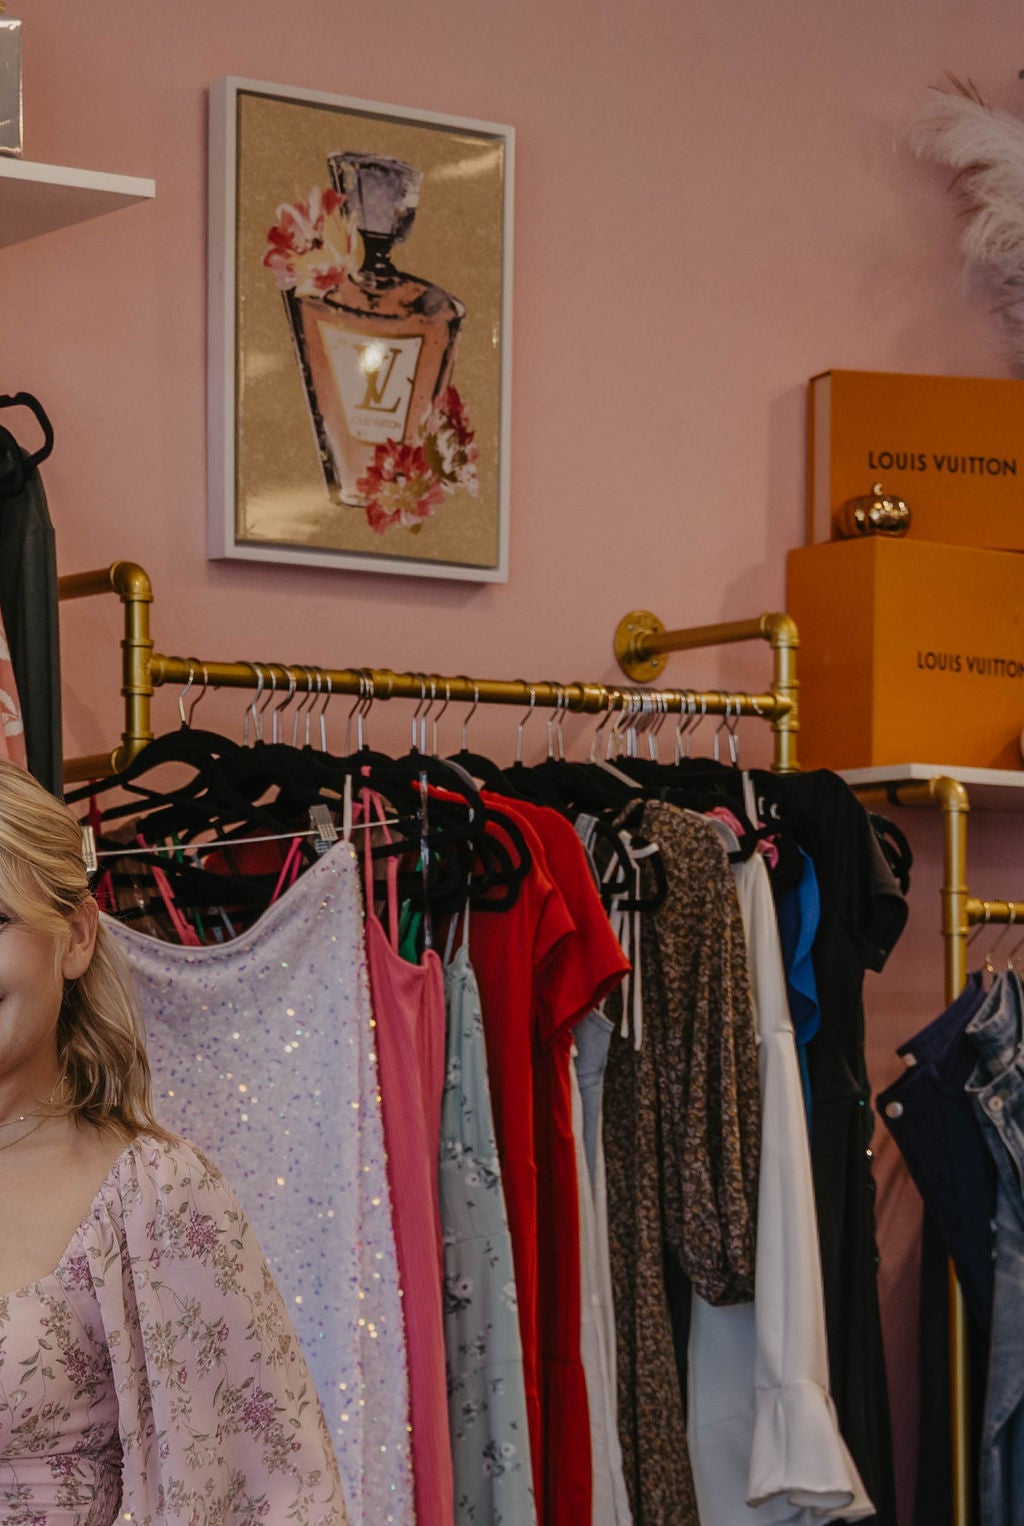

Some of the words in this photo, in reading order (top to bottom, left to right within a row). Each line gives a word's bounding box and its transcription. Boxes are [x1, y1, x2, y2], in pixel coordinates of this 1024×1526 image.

[868, 452, 927, 471] LOUIS
[933, 454, 1017, 475] VUITTON
[917, 651, 962, 672] LOUIS
